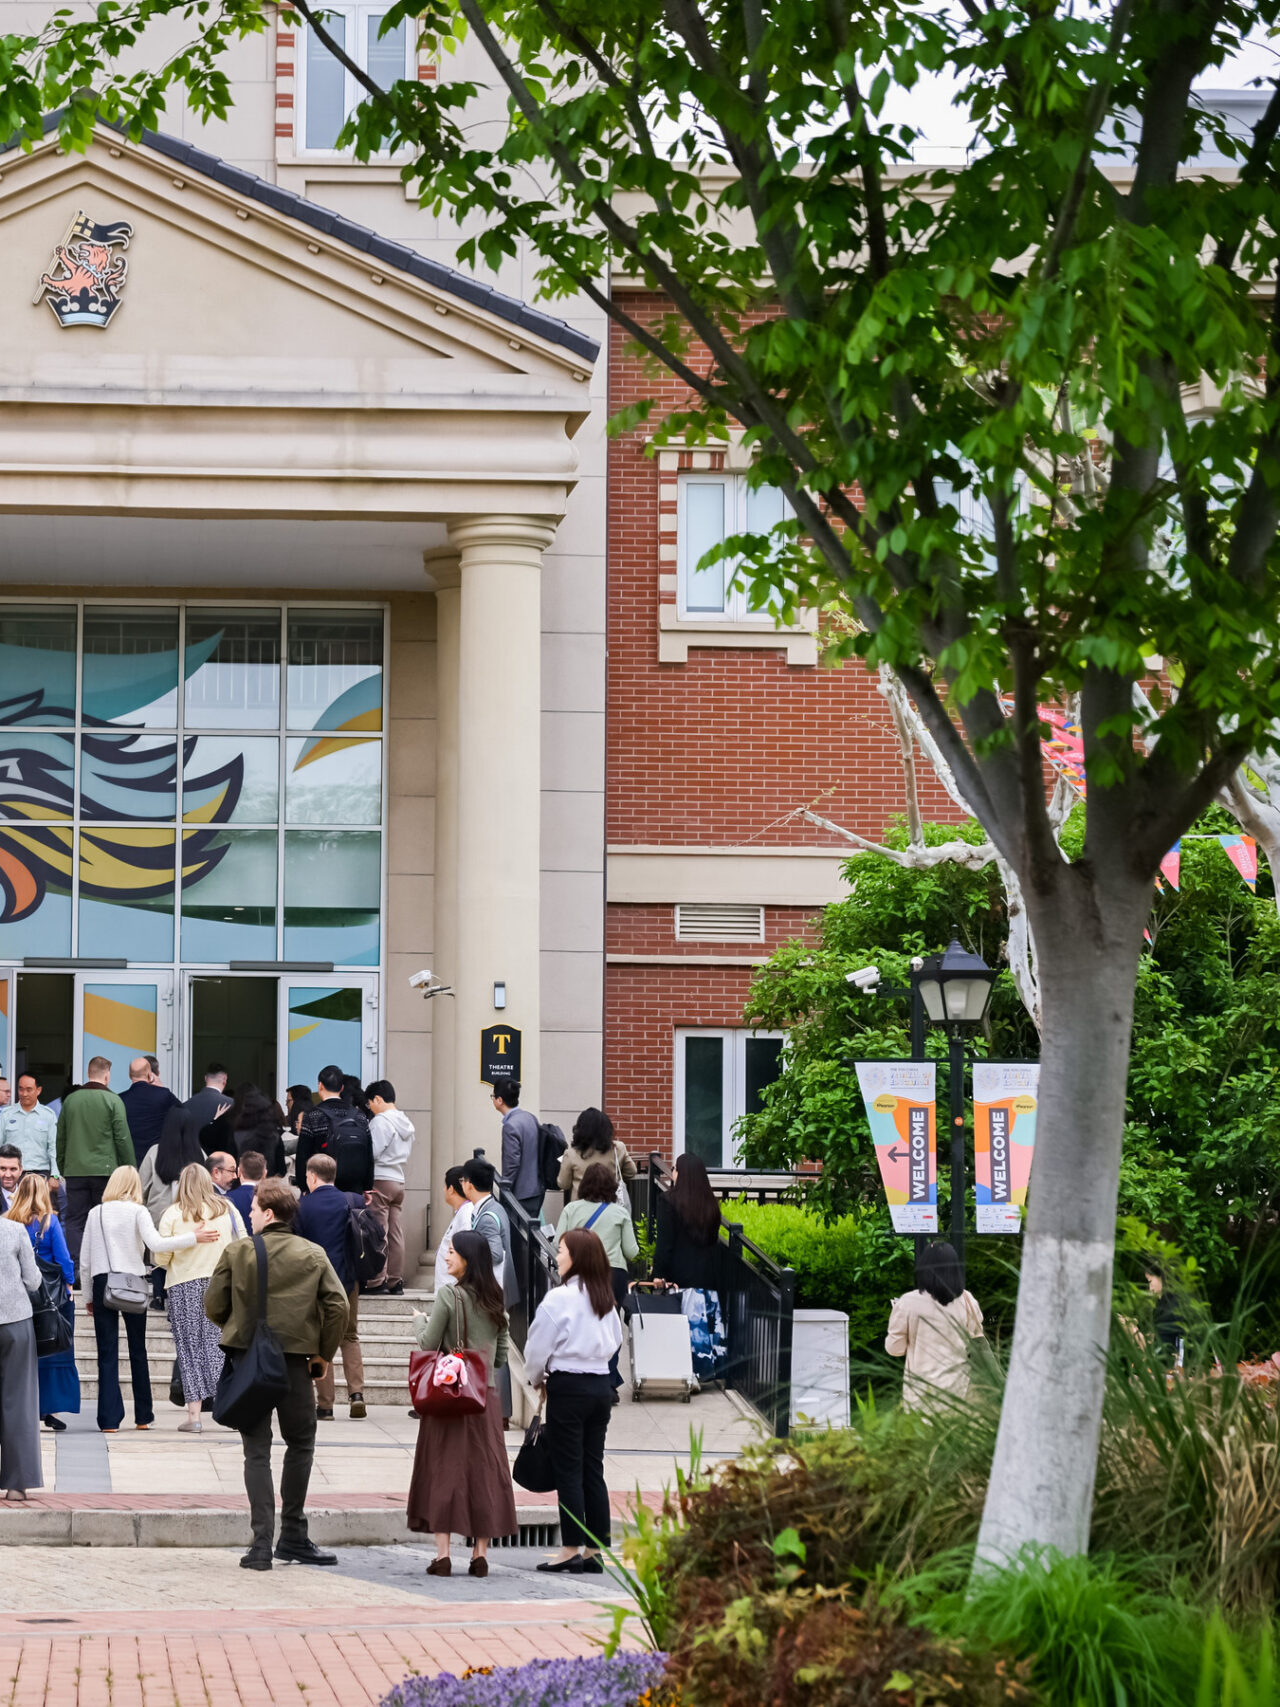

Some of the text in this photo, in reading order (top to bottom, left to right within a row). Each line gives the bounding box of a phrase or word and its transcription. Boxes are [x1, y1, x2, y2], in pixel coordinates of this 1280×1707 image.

[493, 1034, 511, 1054] T
[912, 1111, 925, 1200] WELCOME
[992, 1111, 1008, 1200] WELCOME
